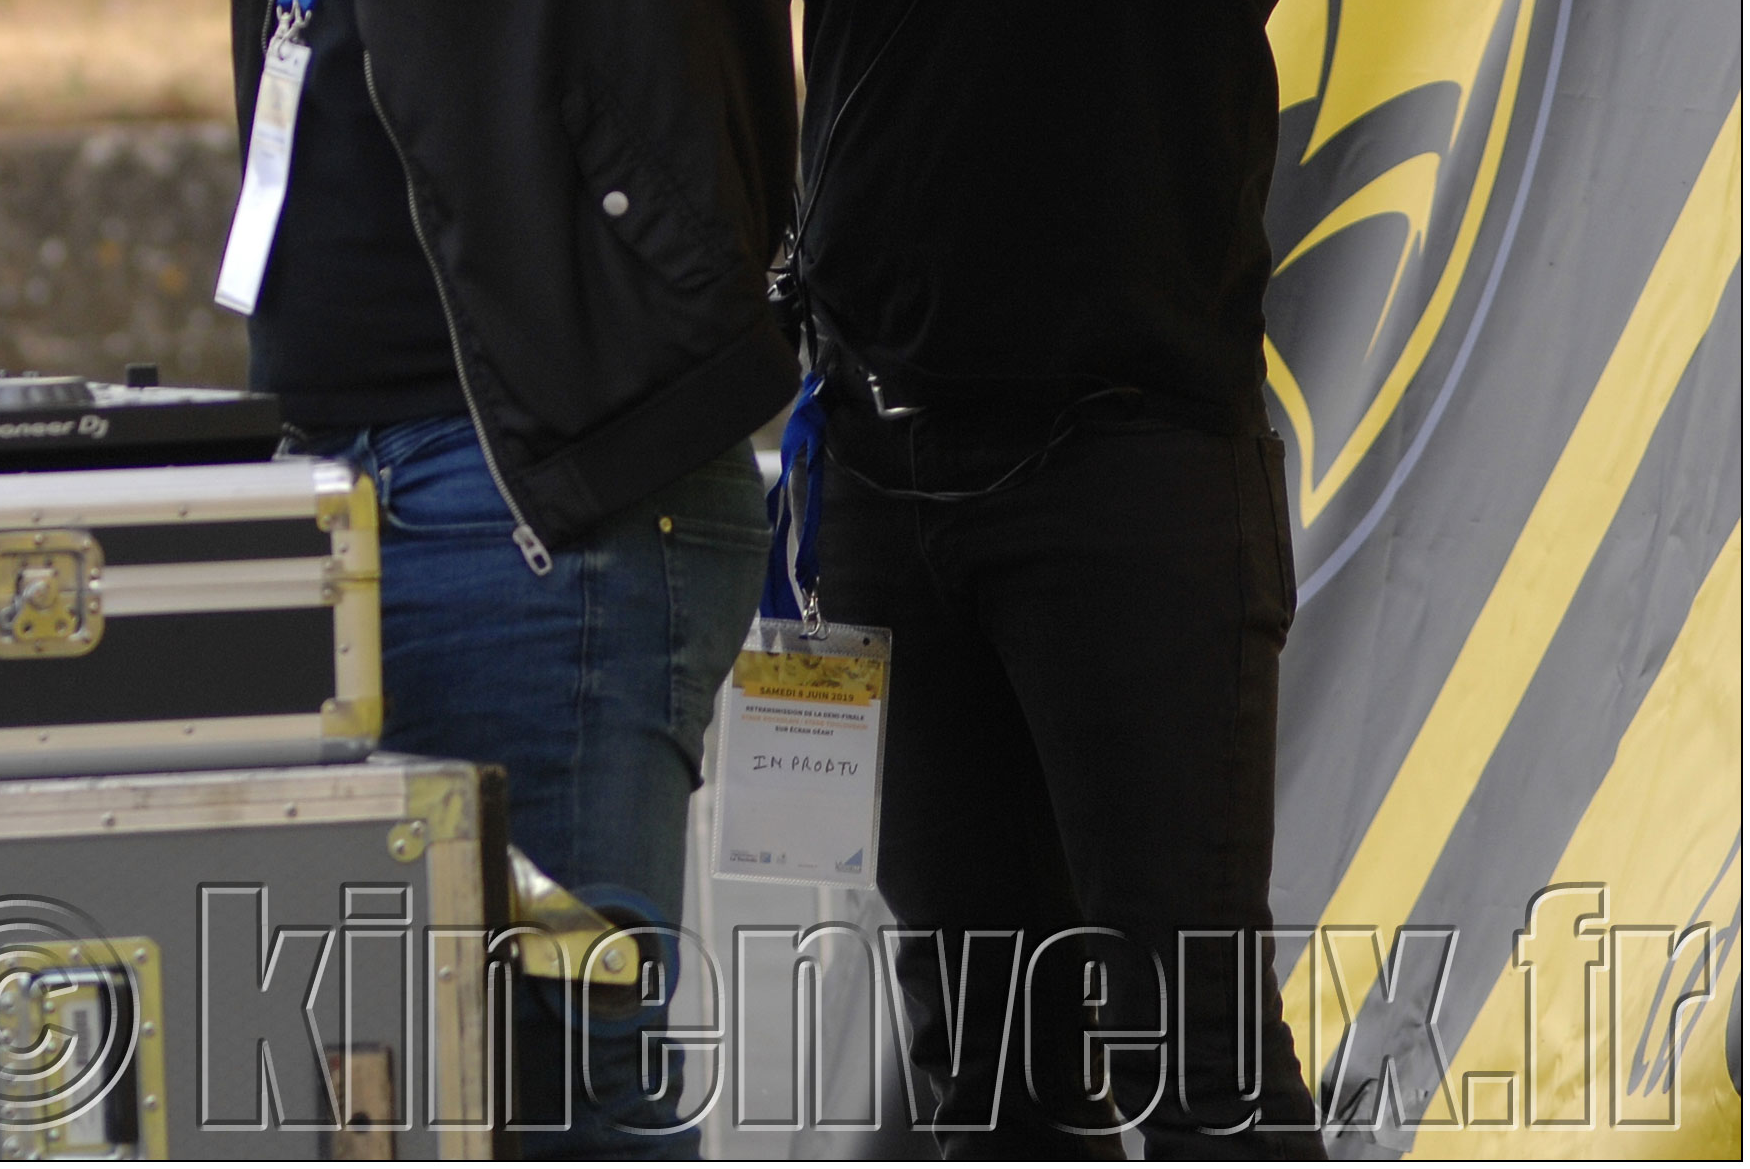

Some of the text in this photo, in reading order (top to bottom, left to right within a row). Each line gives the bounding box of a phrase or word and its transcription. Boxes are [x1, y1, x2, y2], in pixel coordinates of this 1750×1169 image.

[759, 686, 796, 698] SAMEDI
[805, 690, 829, 701] JUIN
[831, 692, 855, 703] 2019
[745, 705, 803, 717] RETRANSMISSION
